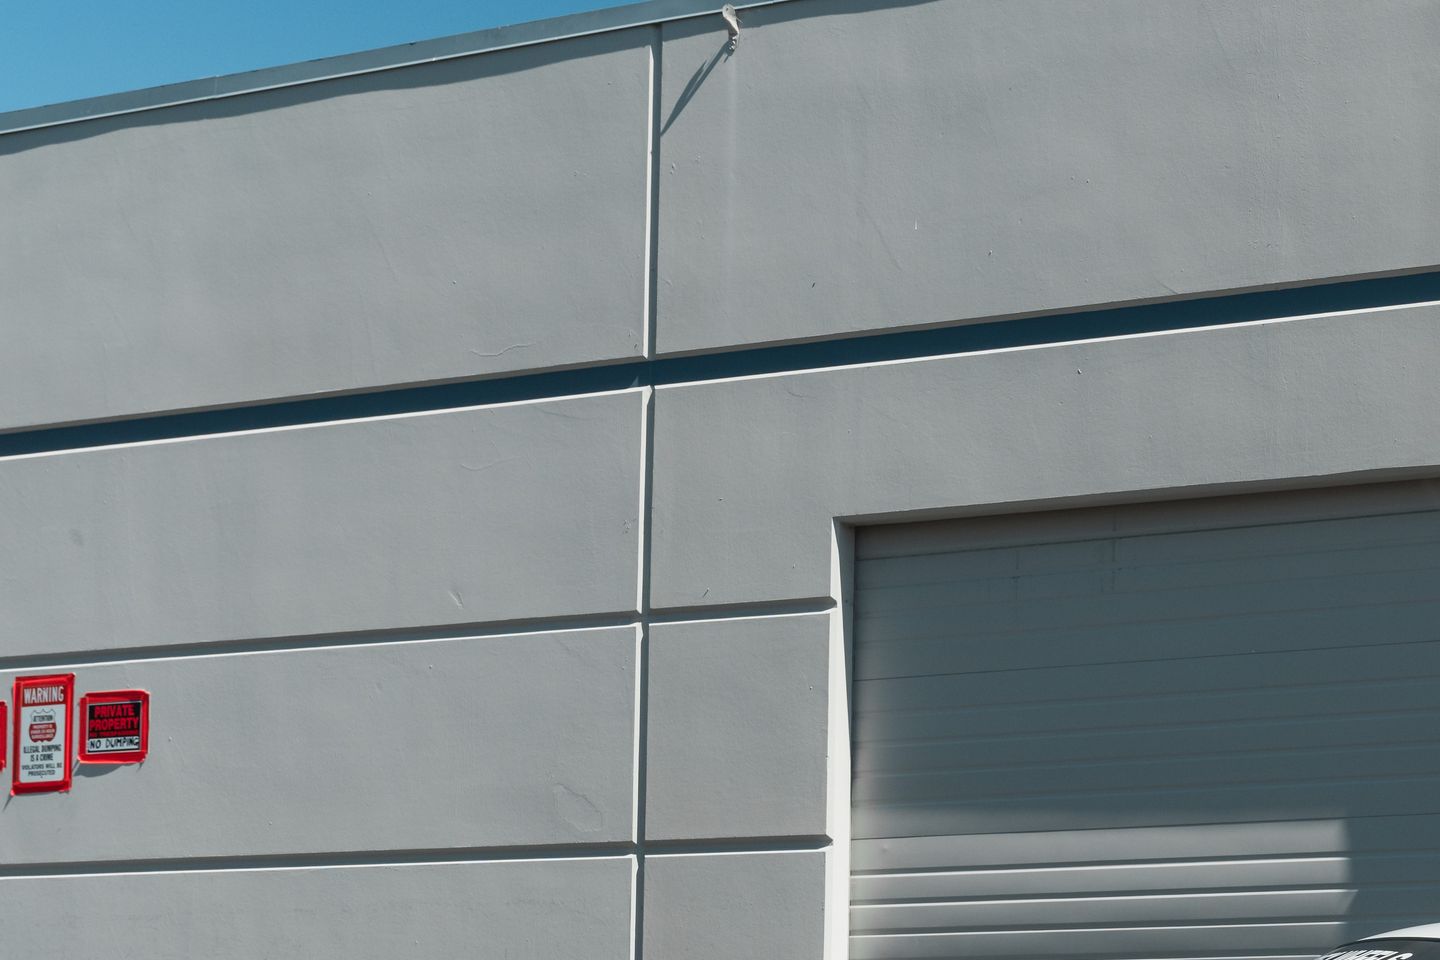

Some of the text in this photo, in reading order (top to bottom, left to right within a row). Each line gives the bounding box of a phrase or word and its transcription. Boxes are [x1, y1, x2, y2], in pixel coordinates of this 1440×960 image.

[23, 686, 65, 704] WARNING
[95, 704, 135, 717] PRIVATE
[89, 717, 139, 730] PROPERTY
[90, 737, 139, 749] NO DUMPING
